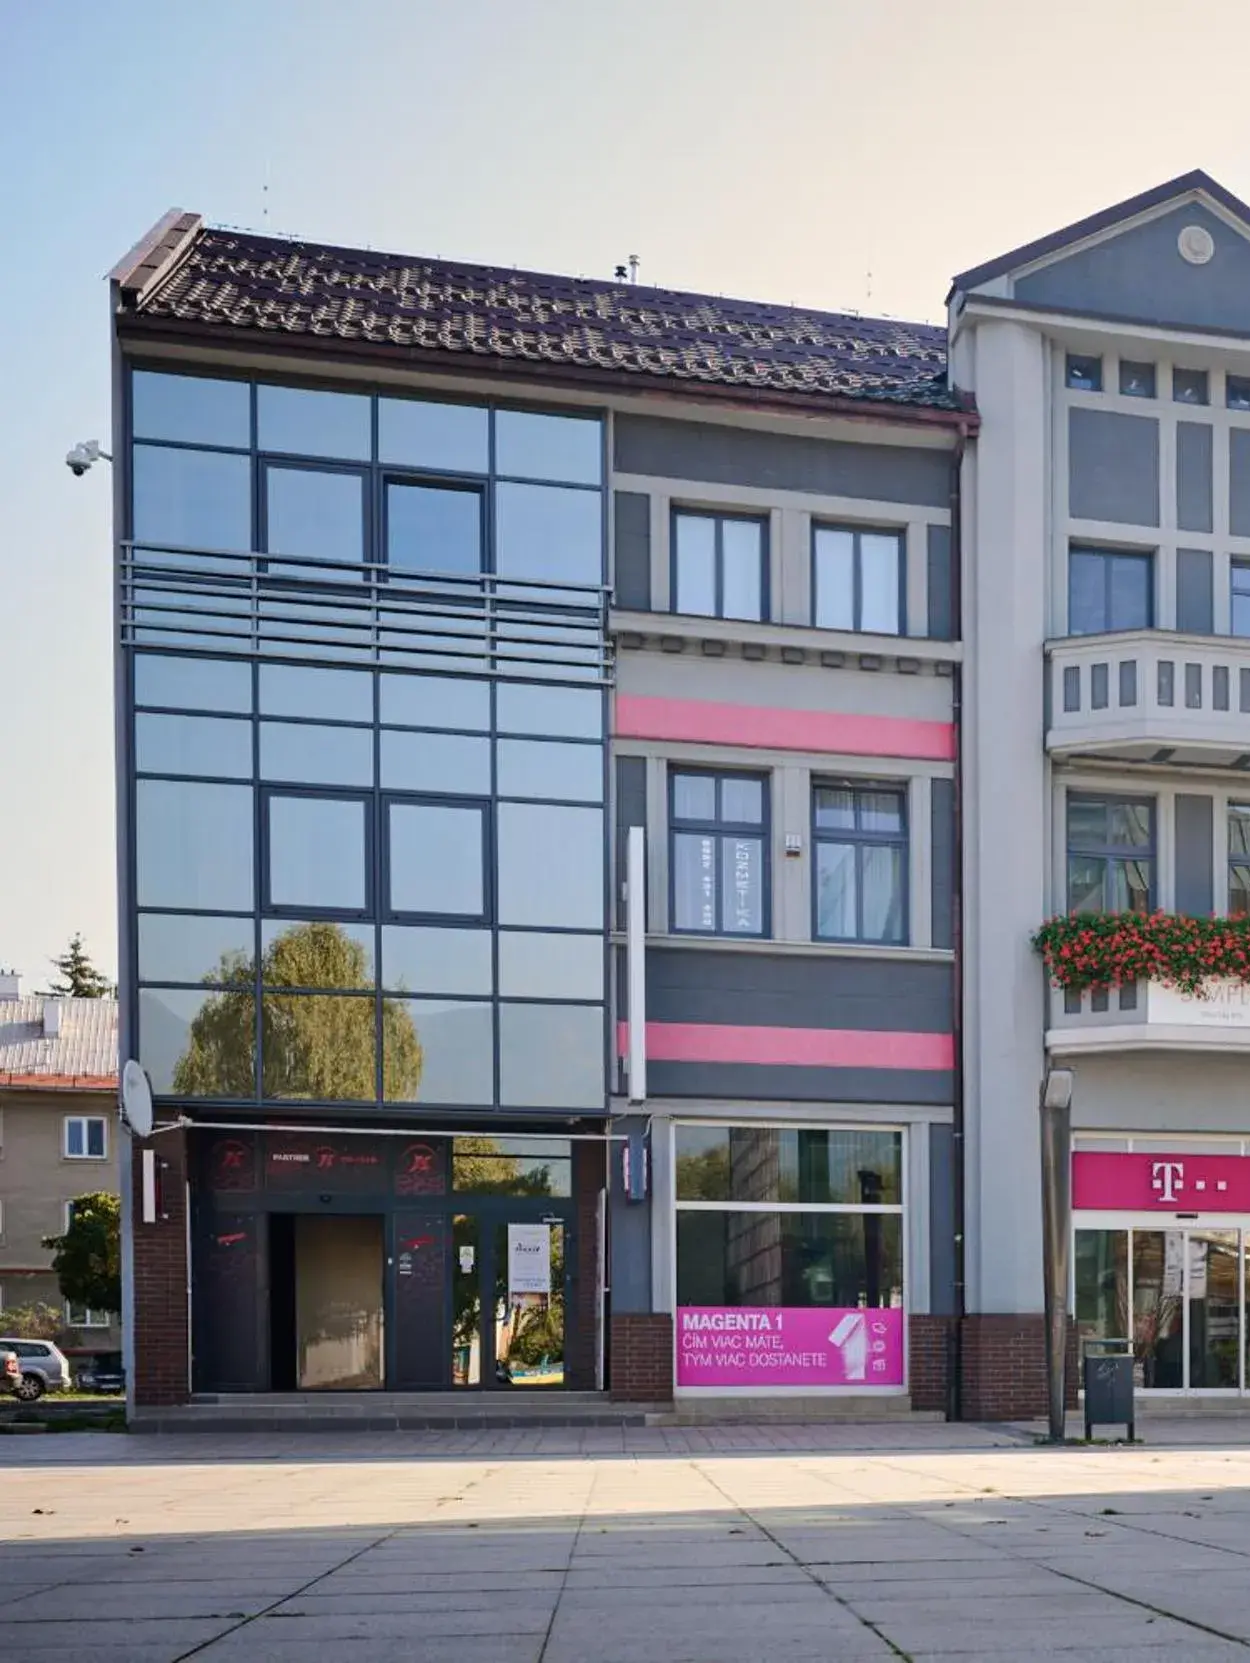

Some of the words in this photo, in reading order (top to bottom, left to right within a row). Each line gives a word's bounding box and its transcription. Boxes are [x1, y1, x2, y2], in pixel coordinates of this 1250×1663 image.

[683, 1313, 771, 1331] MAGENTA
[775, 1313, 784, 1331] 1
[711, 1334, 742, 1350] VIAC
[715, 1352, 746, 1367] VIAC
[748, 1352, 827, 1368] DOSTANETE
